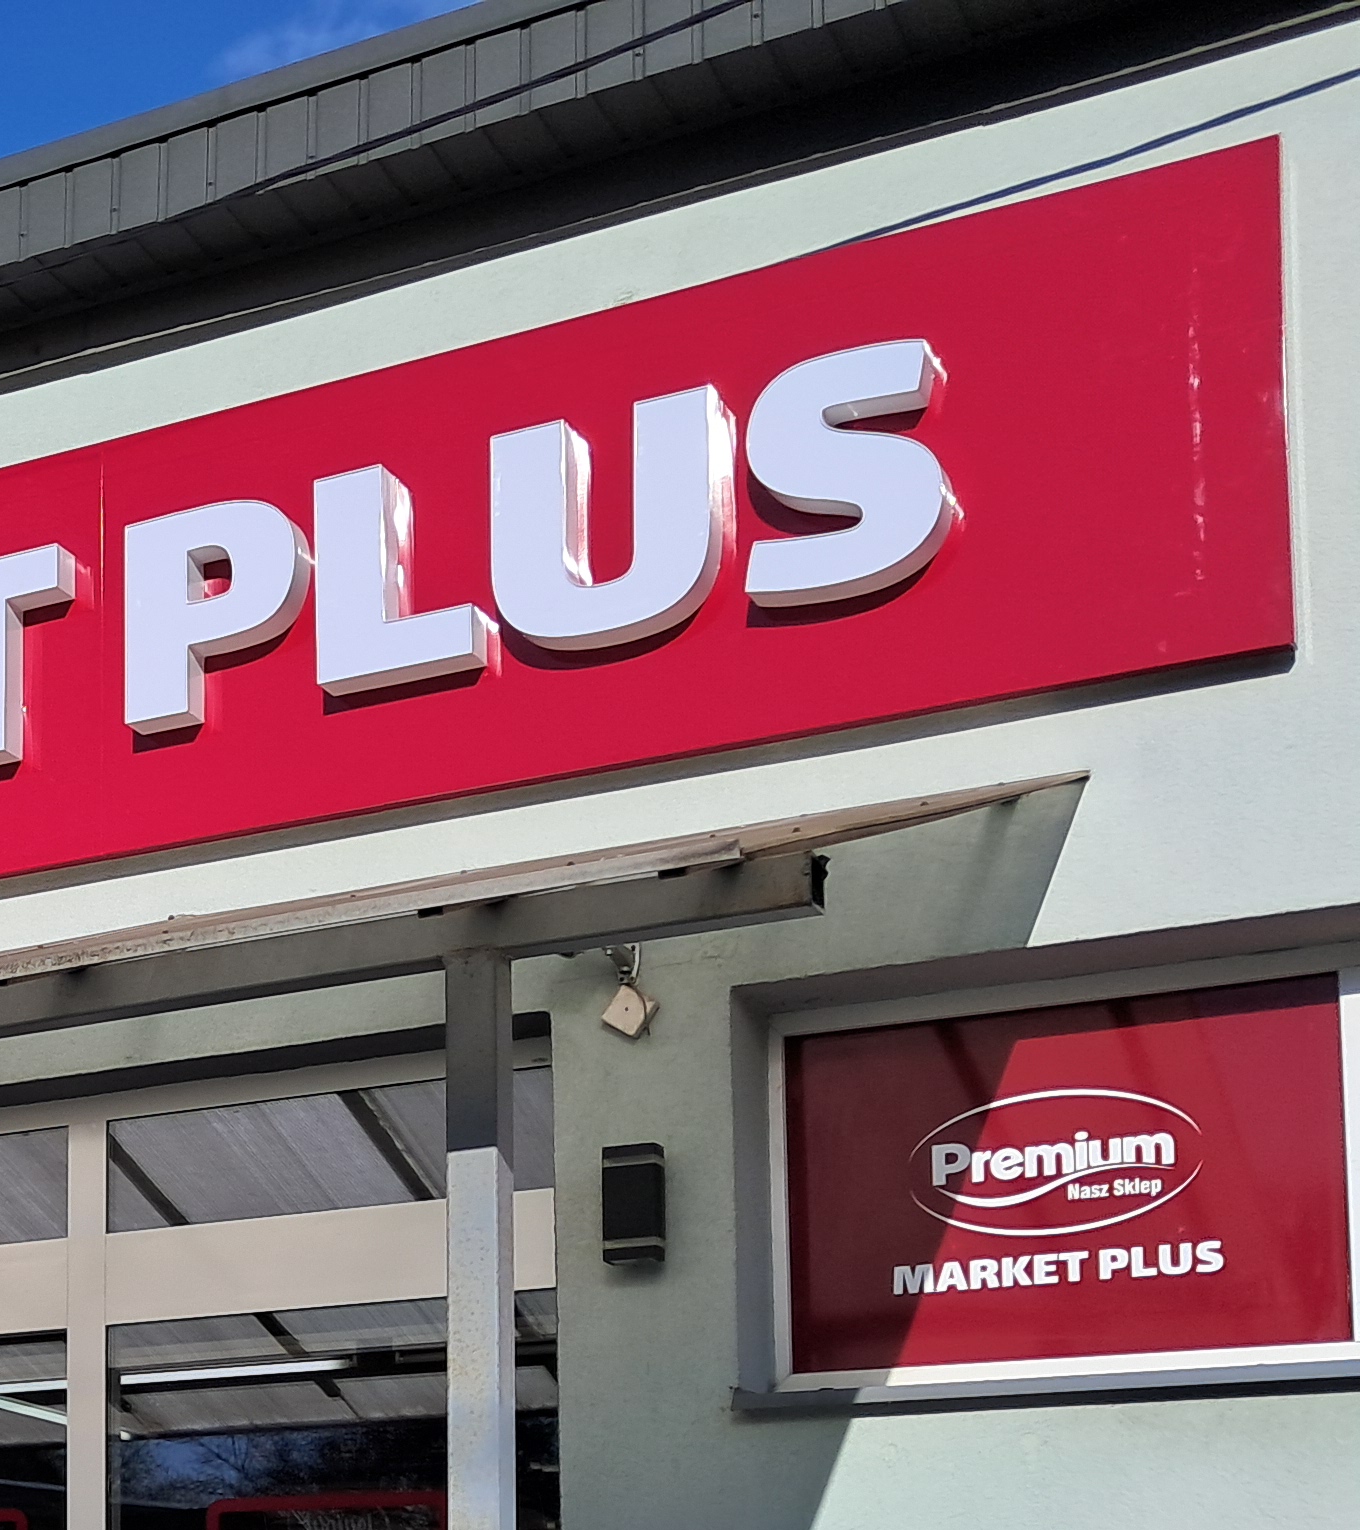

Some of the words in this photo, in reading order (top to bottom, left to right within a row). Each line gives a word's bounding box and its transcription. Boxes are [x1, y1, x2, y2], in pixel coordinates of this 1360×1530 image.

[123, 338, 966, 736] PLUS
[931, 1130, 1176, 1187] Premium
[1067, 1181, 1110, 1201] Nasz
[1112, 1176, 1163, 1199] Sklep
[892, 1250, 1089, 1296] MARKET
[1097, 1239, 1225, 1281] PLUS
